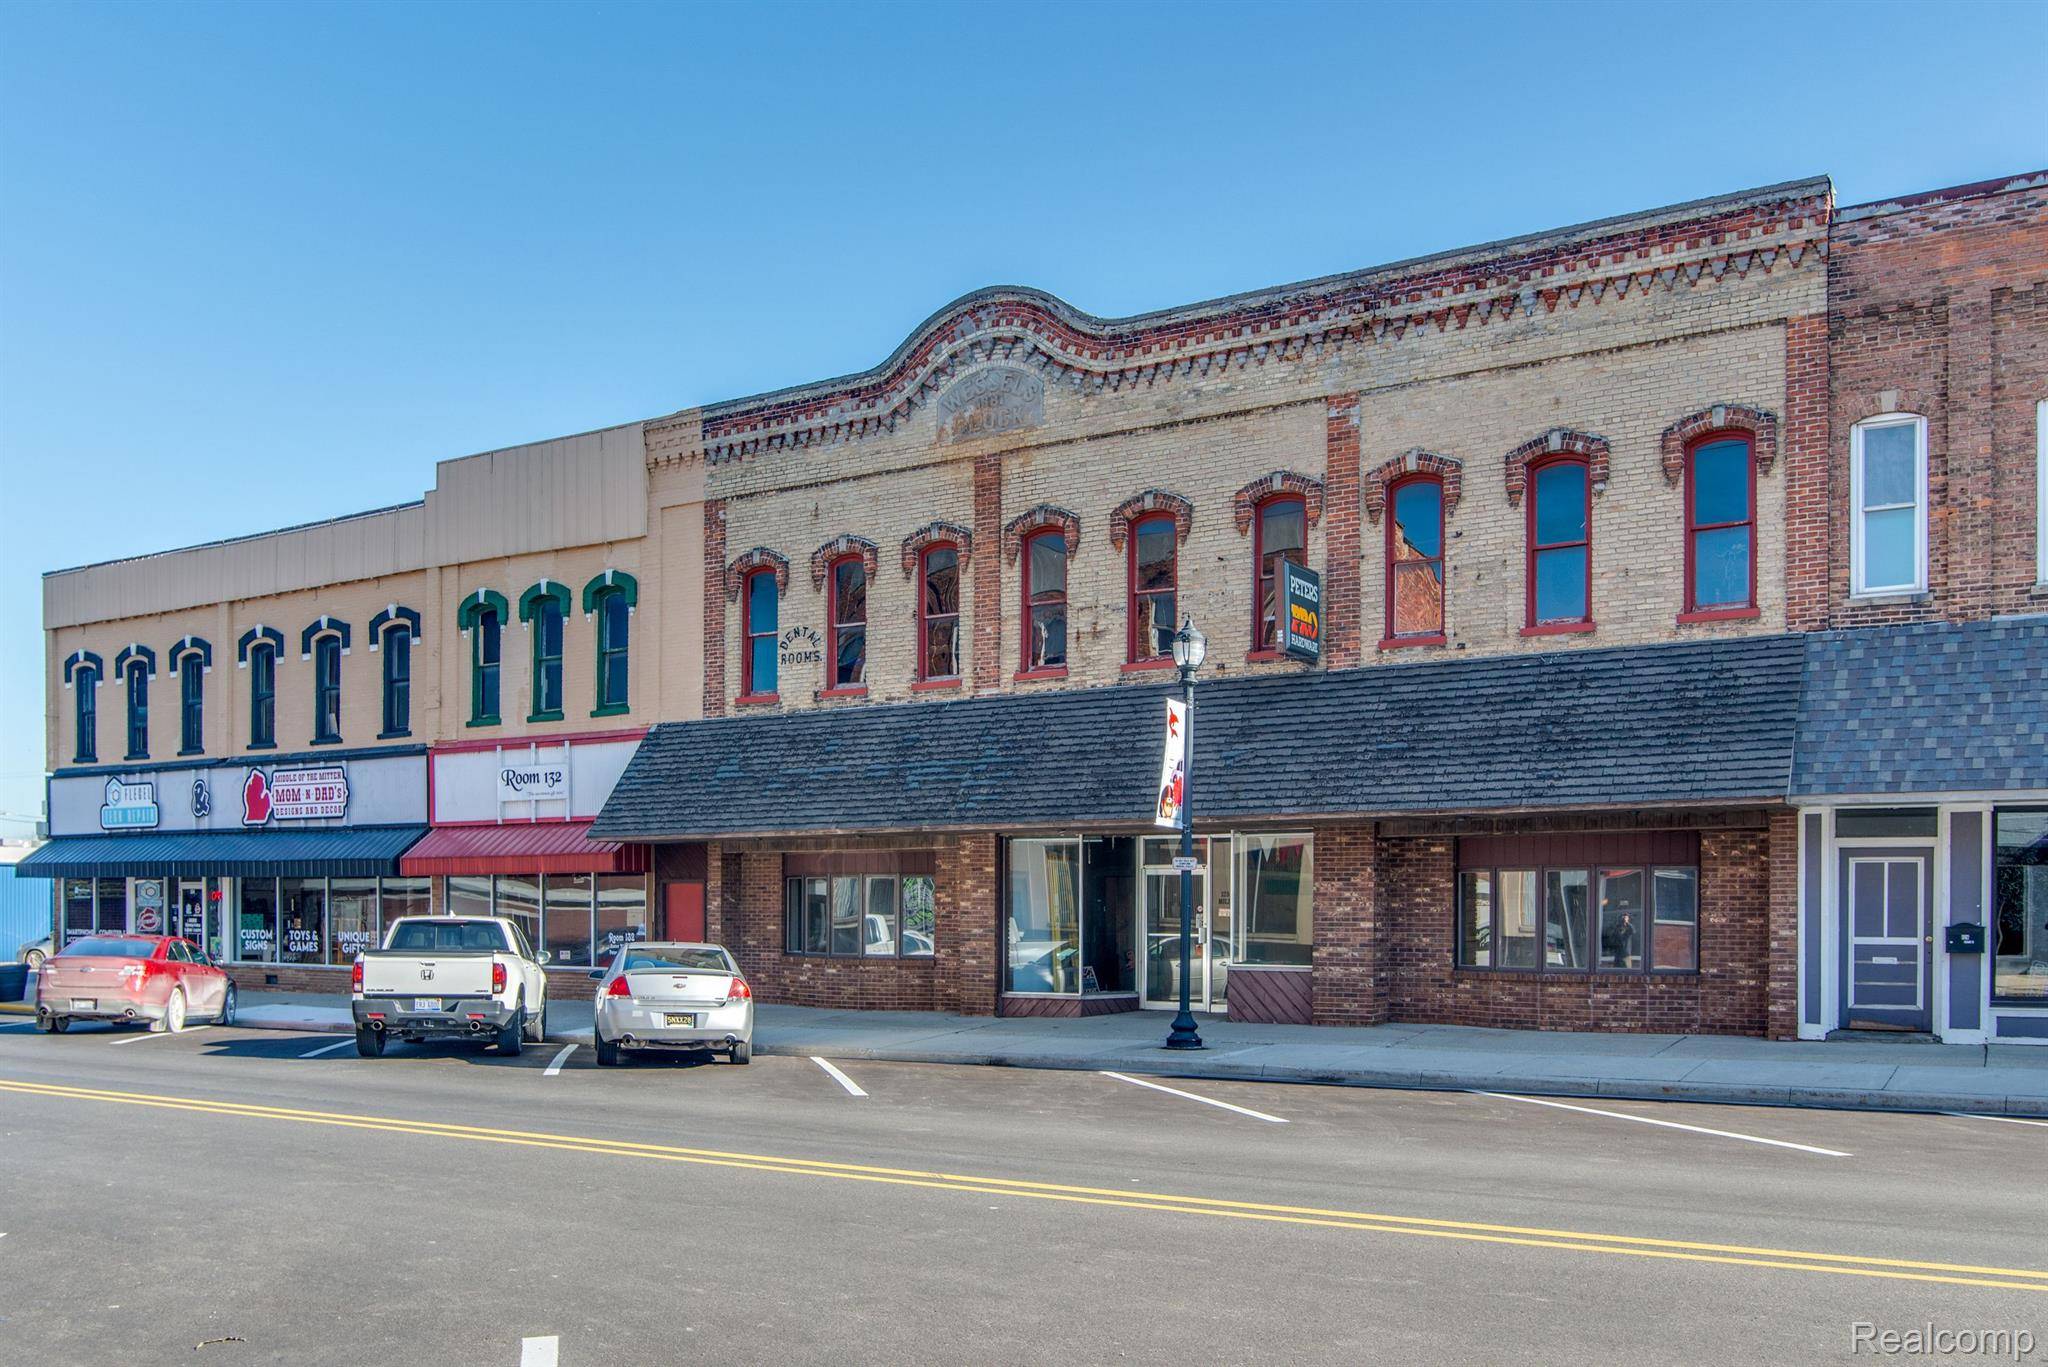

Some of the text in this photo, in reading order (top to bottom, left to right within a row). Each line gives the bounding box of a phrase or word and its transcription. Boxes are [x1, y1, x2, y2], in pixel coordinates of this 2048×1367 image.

[1290, 575, 1318, 603] PETERS
[779, 626, 822, 651] DENTAL
[1291, 633, 1318, 653] HARDWARE
[275, 771, 342, 783] MIDDLE OF THE MITTEN
[501, 769, 562, 791] Room 132
[275, 787, 301, 802] MOM
[276, 805, 342, 815] DESIGNS AND DECOR
[240, 929, 273, 940] CUSTOM
[289, 930, 319, 941] TOYS &
[338, 931, 370, 943] UNIQUE
[608, 932, 624, 944] Room
[244, 940, 268, 950] SIGNS
[289, 941, 319, 952] GAMES
